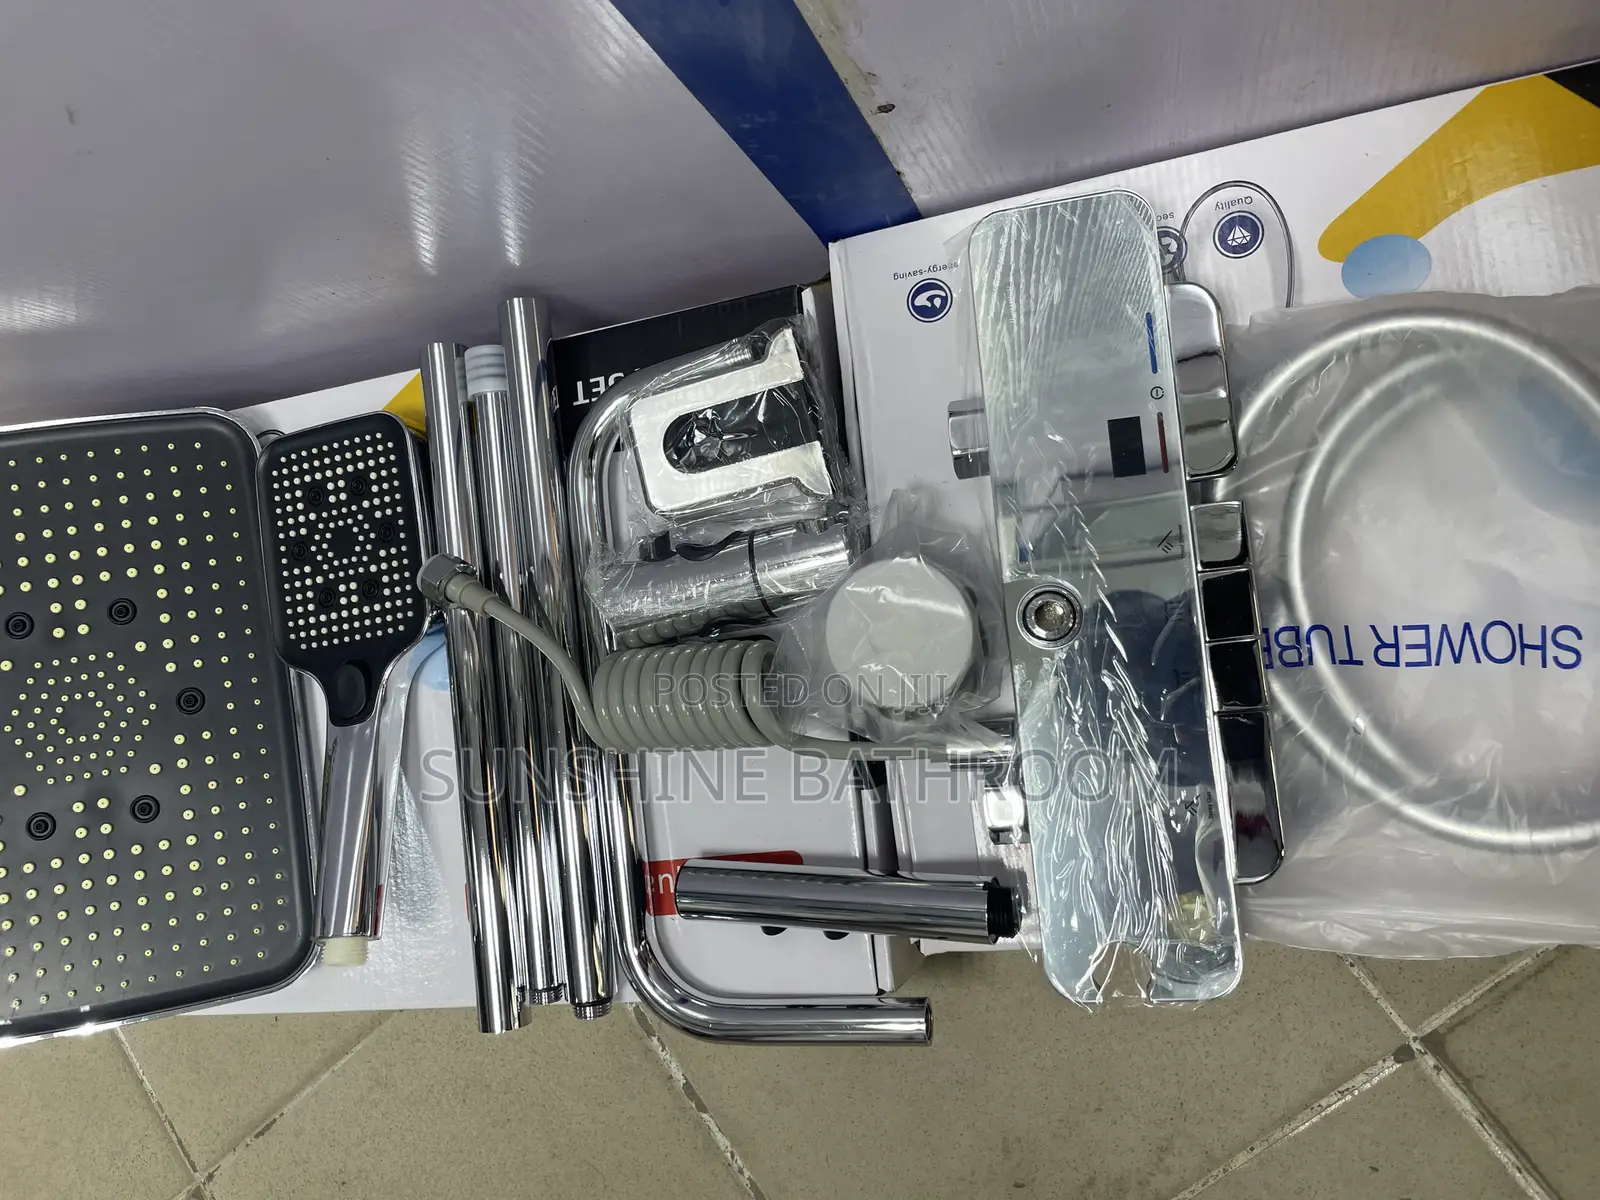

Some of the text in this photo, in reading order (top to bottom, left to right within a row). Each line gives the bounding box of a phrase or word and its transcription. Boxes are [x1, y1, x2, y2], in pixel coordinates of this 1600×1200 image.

[1214, 195, 1253, 211] Quality
[893, 261, 959, 281] energy-saving
[1369, 619, 1583, 670] SHOWER
